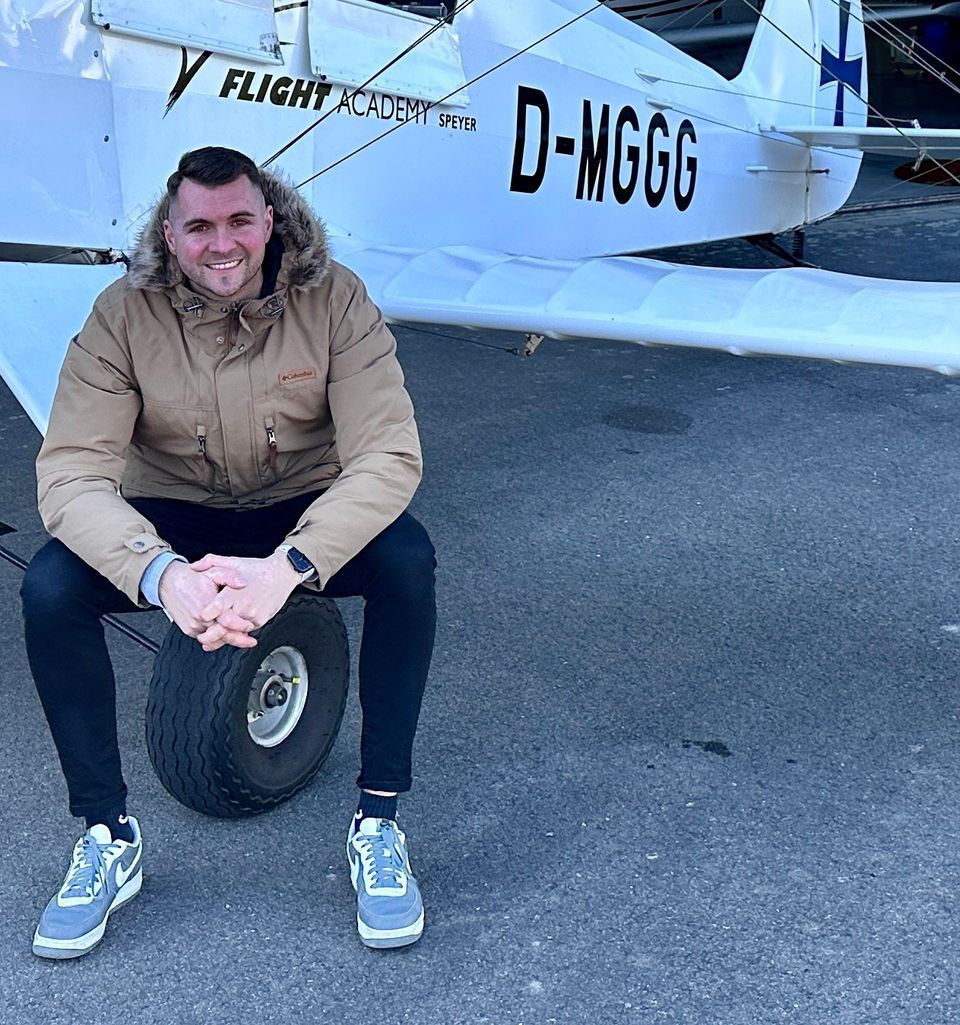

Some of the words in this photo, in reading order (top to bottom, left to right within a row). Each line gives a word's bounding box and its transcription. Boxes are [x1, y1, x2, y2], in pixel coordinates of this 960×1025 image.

[219, 68, 333, 111] FLIGHT
[337, 88, 432, 125] ACADEMY
[439, 113, 477, 132] SPEYER
[509, 85, 698, 212] D-MGGG
